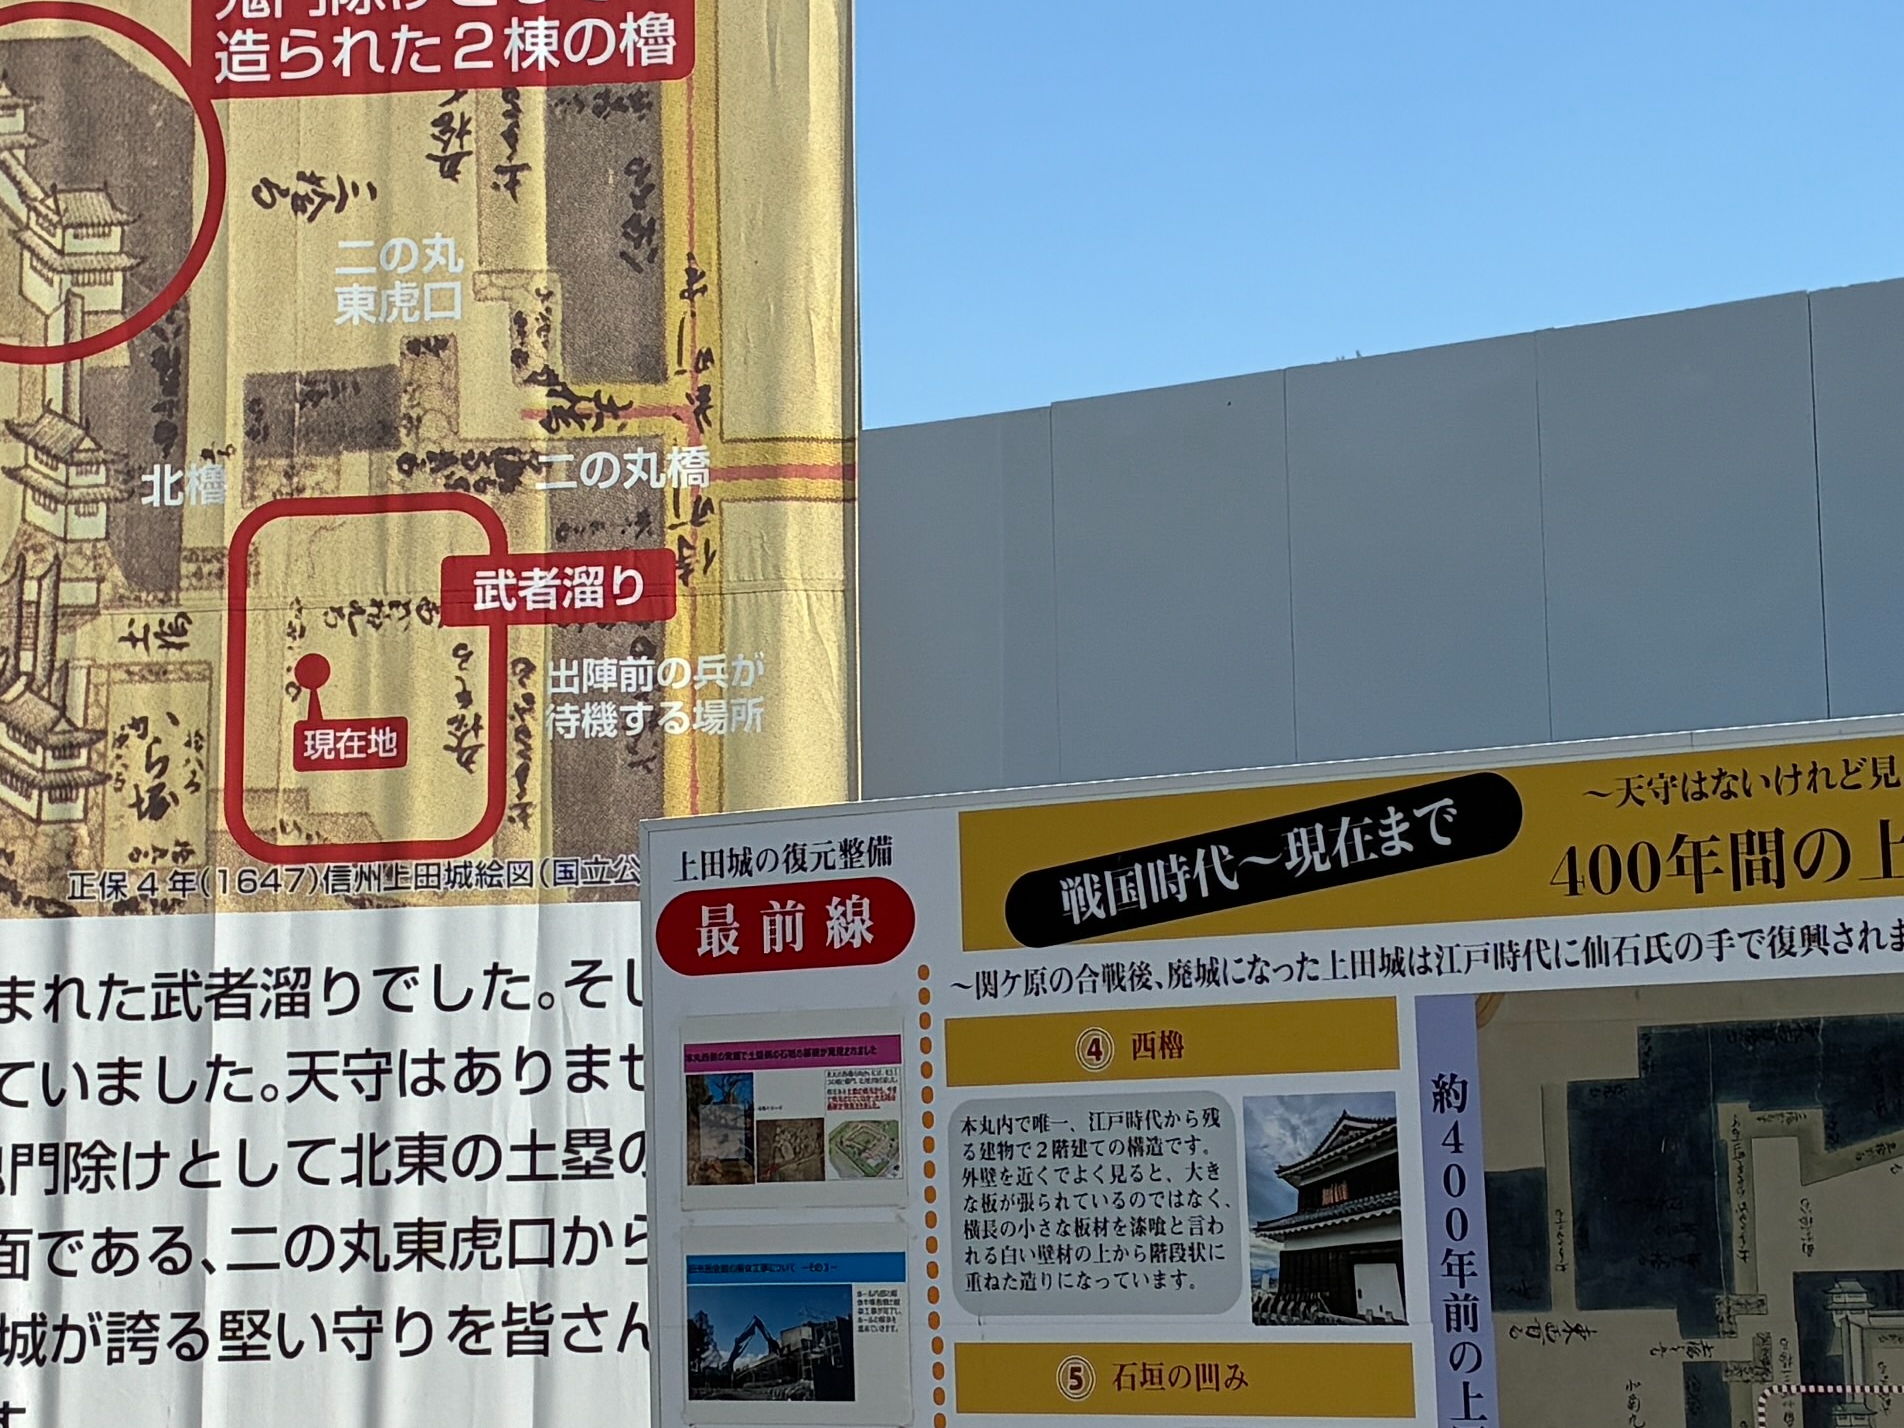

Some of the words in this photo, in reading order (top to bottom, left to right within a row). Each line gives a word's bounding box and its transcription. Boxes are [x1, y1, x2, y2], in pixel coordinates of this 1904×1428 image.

[335, 233, 464, 274] 二の丸
[335, 282, 463, 326] 東虎口
[141, 464, 227, 507] 北櫓
[537, 446, 711, 491] 二の丸橋
[472, 567, 645, 611] 武者溜り
[546, 652, 765, 693] 出陣前の兵が
[545, 700, 765, 740] 待機する場所
[303, 728, 398, 761] 現在地
[673, 835, 893, 882] 上田城の復元整備
[697, 896, 874, 958] 最前線
[1131, 1030, 1184, 1061] 西櫓
[961, 1109, 1220, 1135] 本丸内で唯一、江戸時代から残
[962, 1161, 1221, 1188] 外壁を近くでよく見ると、大き
[964, 1188, 1231, 1215] な板が張られているのではなく、
[963, 1215, 1224, 1241] 横長の小さな板材を漆喰と言わ
[965, 1242, 1225, 1266] れる白い壁材の上から階段状に
[966, 1269, 1196, 1292] 重ねた造りになっています。
[1113, 1362, 1249, 1393] 石垣の凹み
